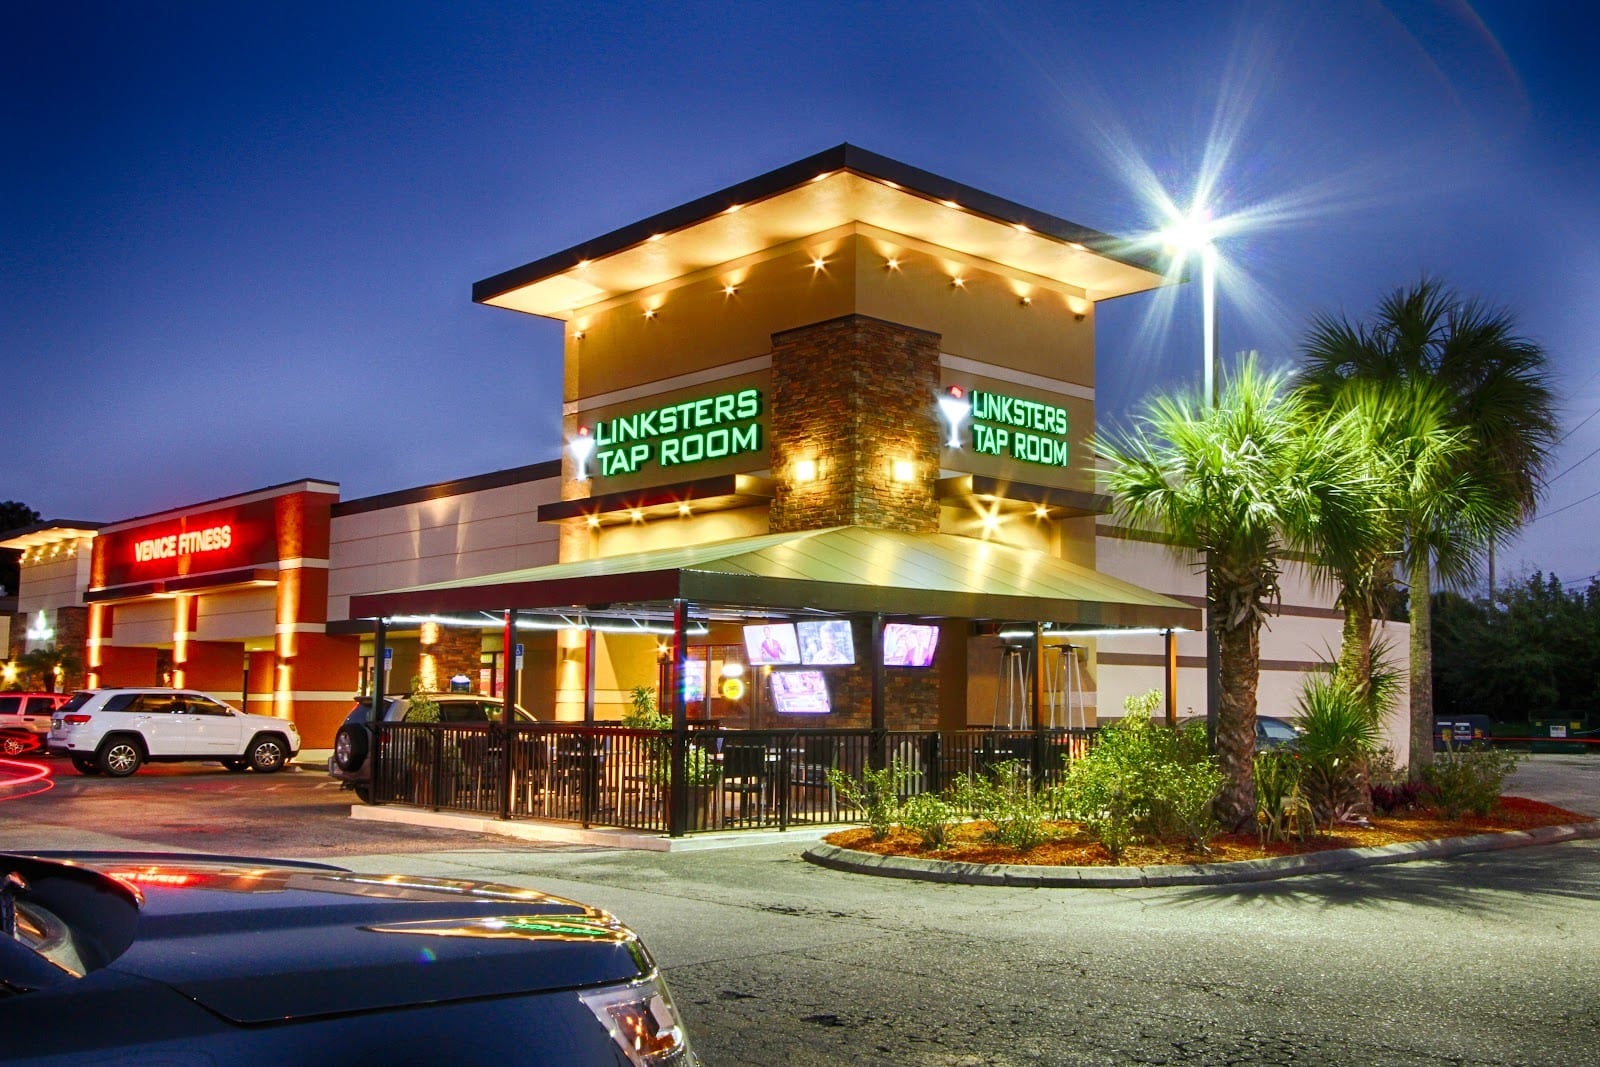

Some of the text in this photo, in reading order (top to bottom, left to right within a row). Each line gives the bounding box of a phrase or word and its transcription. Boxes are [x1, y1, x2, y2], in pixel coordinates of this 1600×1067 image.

[596, 388, 762, 447] LINKSTERS
[972, 389, 1068, 435] LINKSTERS
[597, 423, 762, 476] TAP ROOM
[973, 423, 1068, 467] TAP ROOM
[135, 525, 231, 562] VENICE FITNESS
